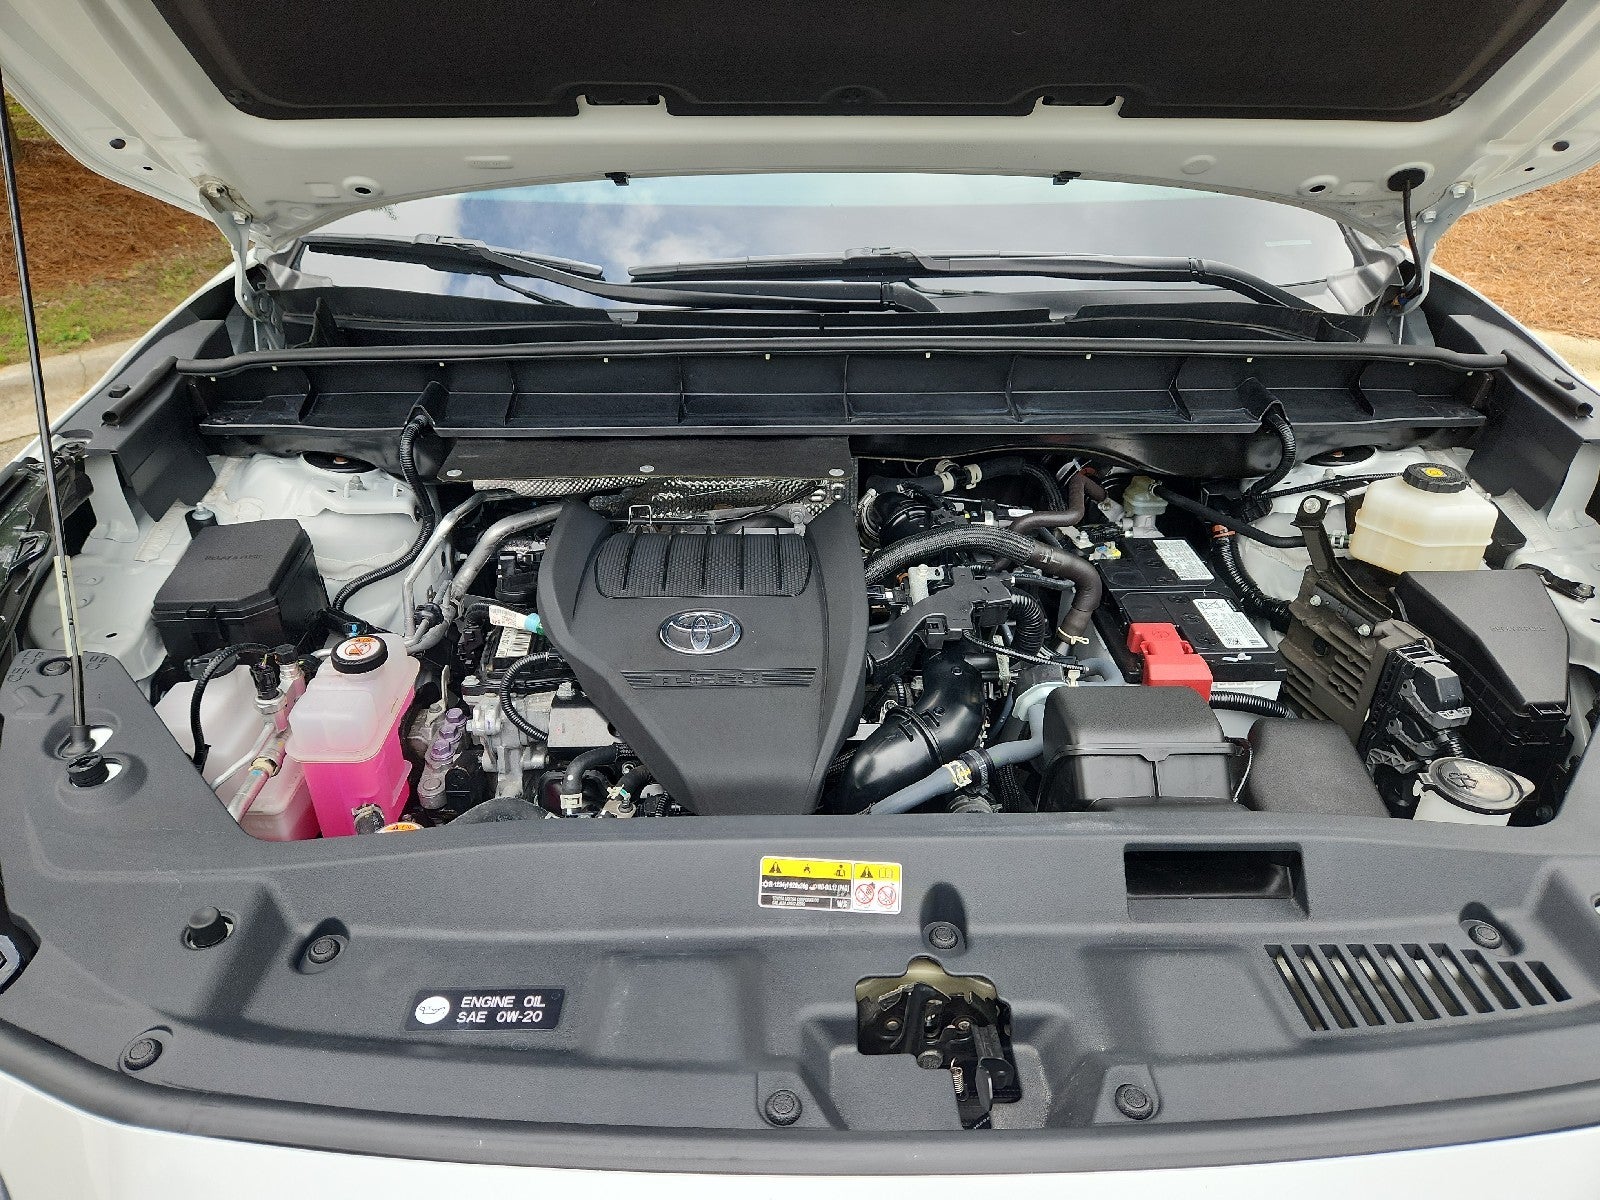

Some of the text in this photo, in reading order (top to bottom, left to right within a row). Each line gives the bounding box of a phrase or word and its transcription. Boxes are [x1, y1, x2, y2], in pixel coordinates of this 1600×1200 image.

[460, 995, 546, 1008] ENGINE OIL
[455, 1010, 544, 1023] SAE 0W-20
